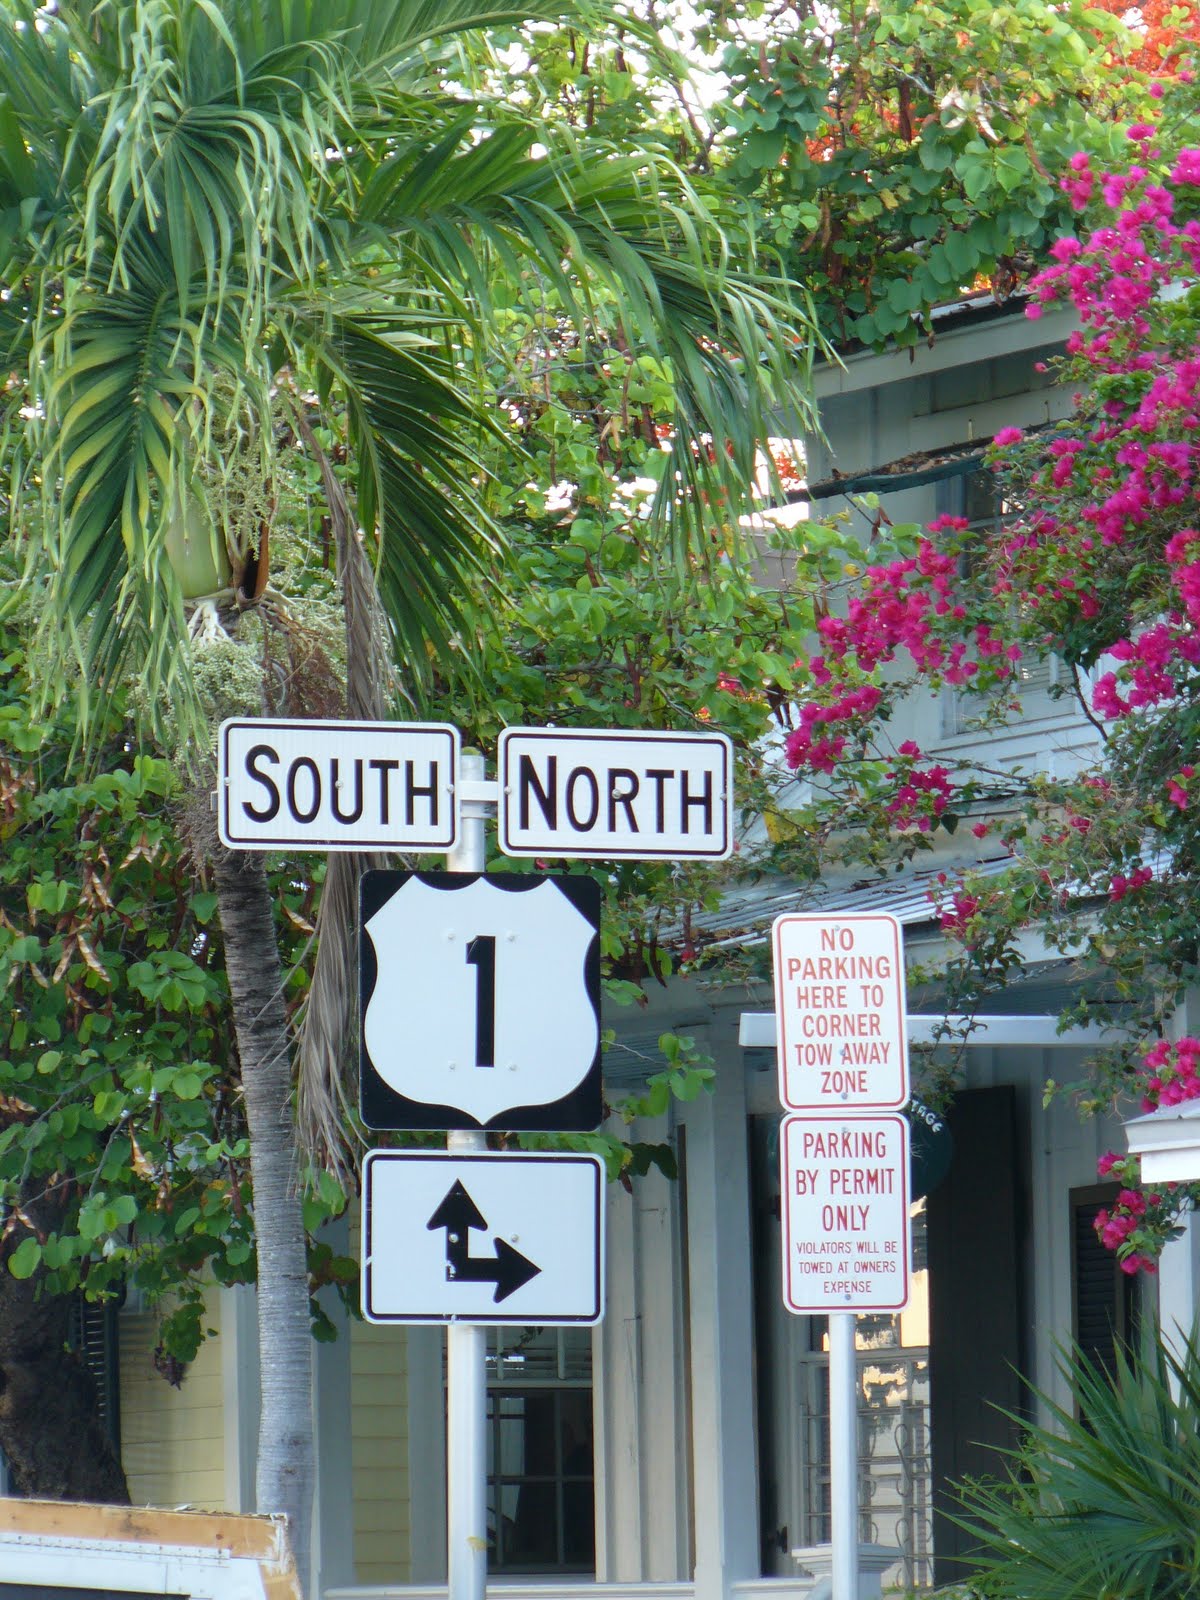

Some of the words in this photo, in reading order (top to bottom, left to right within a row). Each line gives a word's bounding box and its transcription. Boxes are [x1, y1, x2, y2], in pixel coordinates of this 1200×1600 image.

[242, 744, 439, 826] SOUTH
[519, 754, 713, 835] NORTH
[821, 928, 854, 951] NO
[787, 955, 891, 981] PARKING
[466, 935, 496, 1068] 1
[797, 985, 848, 1009] HERE
[860, 984, 884, 1008] TO
[802, 1013, 881, 1038] CORNER
[794, 1043, 833, 1067] TOW
[840, 1041, 891, 1065] AWAY
[820, 1070, 868, 1095] ZONE
[803, 1130, 887, 1159] PARKING
[795, 1169, 819, 1196] BY
[829, 1167, 895, 1195] PERMIT
[821, 1204, 870, 1232] ONLY
[797, 1241, 852, 1255] VIOLATORS
[856, 1241, 880, 1254] WILL
[884, 1240, 898, 1254] BE
[799, 1261, 833, 1274] TOWED
[837, 1261, 849, 1273] AT
[853, 1260, 896, 1274] OWNERS
[823, 1280, 872, 1294] EXPENSE
